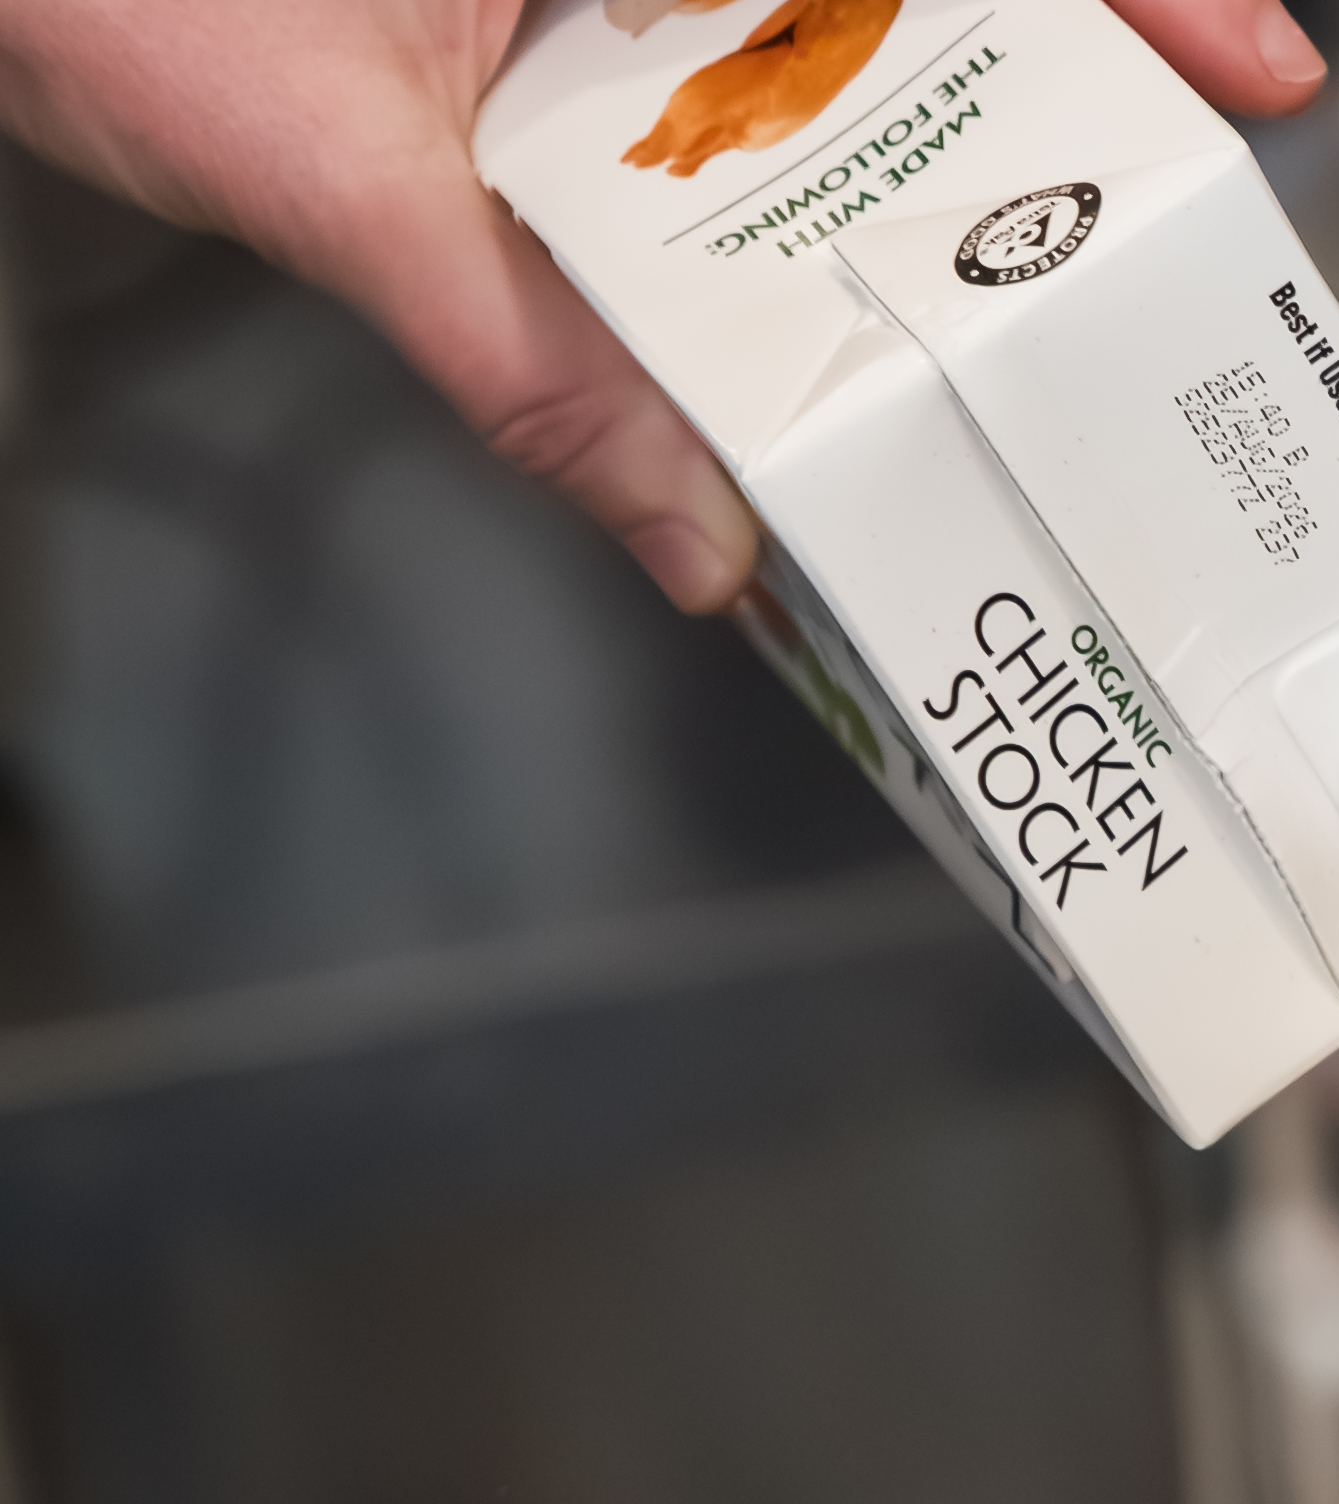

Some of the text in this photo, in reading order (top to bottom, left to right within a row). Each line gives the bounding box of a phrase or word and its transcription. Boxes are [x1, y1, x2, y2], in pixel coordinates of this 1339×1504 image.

[705, 46, 1006, 257] THE FOLLOWING:
[776, 100, 981, 258] MADE WITH
[996, 216, 1094, 283] PROTECTS
[1269, 281, 1318, 345] Best
[1304, 337, 1334, 366] if
[1203, 373, 1318, 538] 25/AUG/2026
[1231, 361, 1309, 466] 15:40 B
[1255, 520, 1299, 565] 237
[974, 592, 1188, 891] CHICKEN
[1071, 624, 1172, 768] ORGANIC
[922, 669, 1107, 911] STOCK
